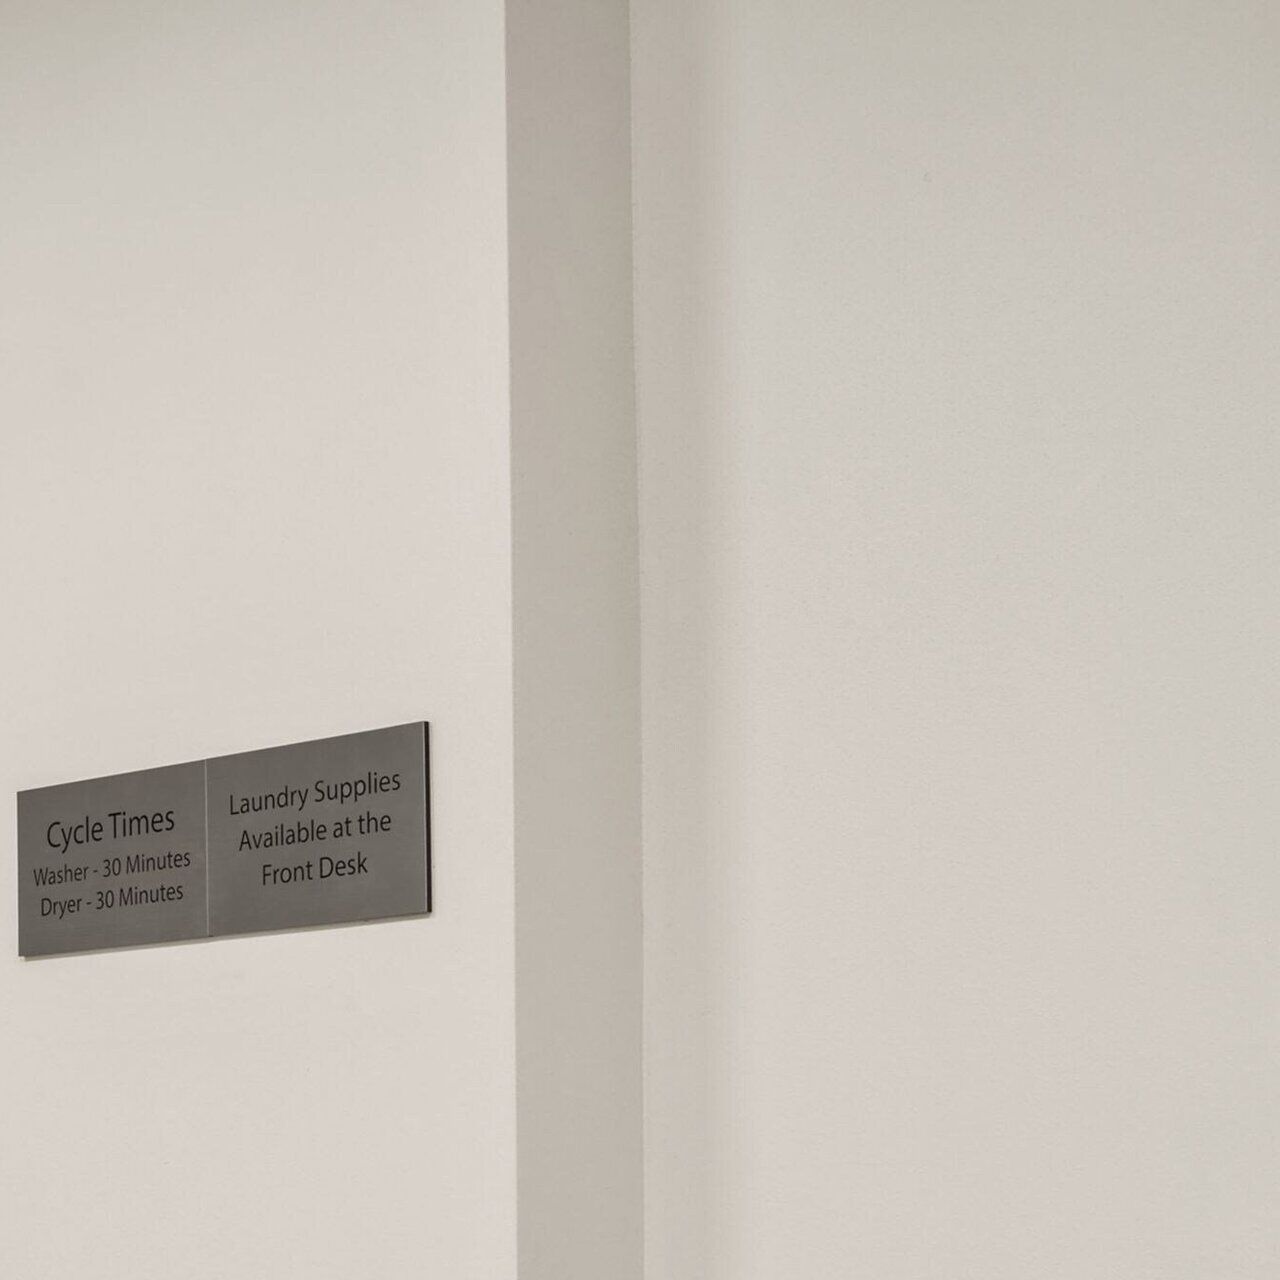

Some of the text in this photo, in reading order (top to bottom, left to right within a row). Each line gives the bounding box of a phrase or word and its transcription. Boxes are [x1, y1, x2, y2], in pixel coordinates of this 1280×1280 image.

[229, 771, 401, 815] Laundry Supplies
[46, 808, 176, 852] Cycle Times
[238, 811, 392, 851] Available at the
[33, 864, 89, 887] Washer
[102, 857, 122, 877] 30
[126, 849, 191, 874] Minutes
[261, 851, 368, 886] Front Desk
[40, 889, 83, 917] Dryer
[95, 890, 115, 910] 30
[119, 883, 184, 907] Minutes
